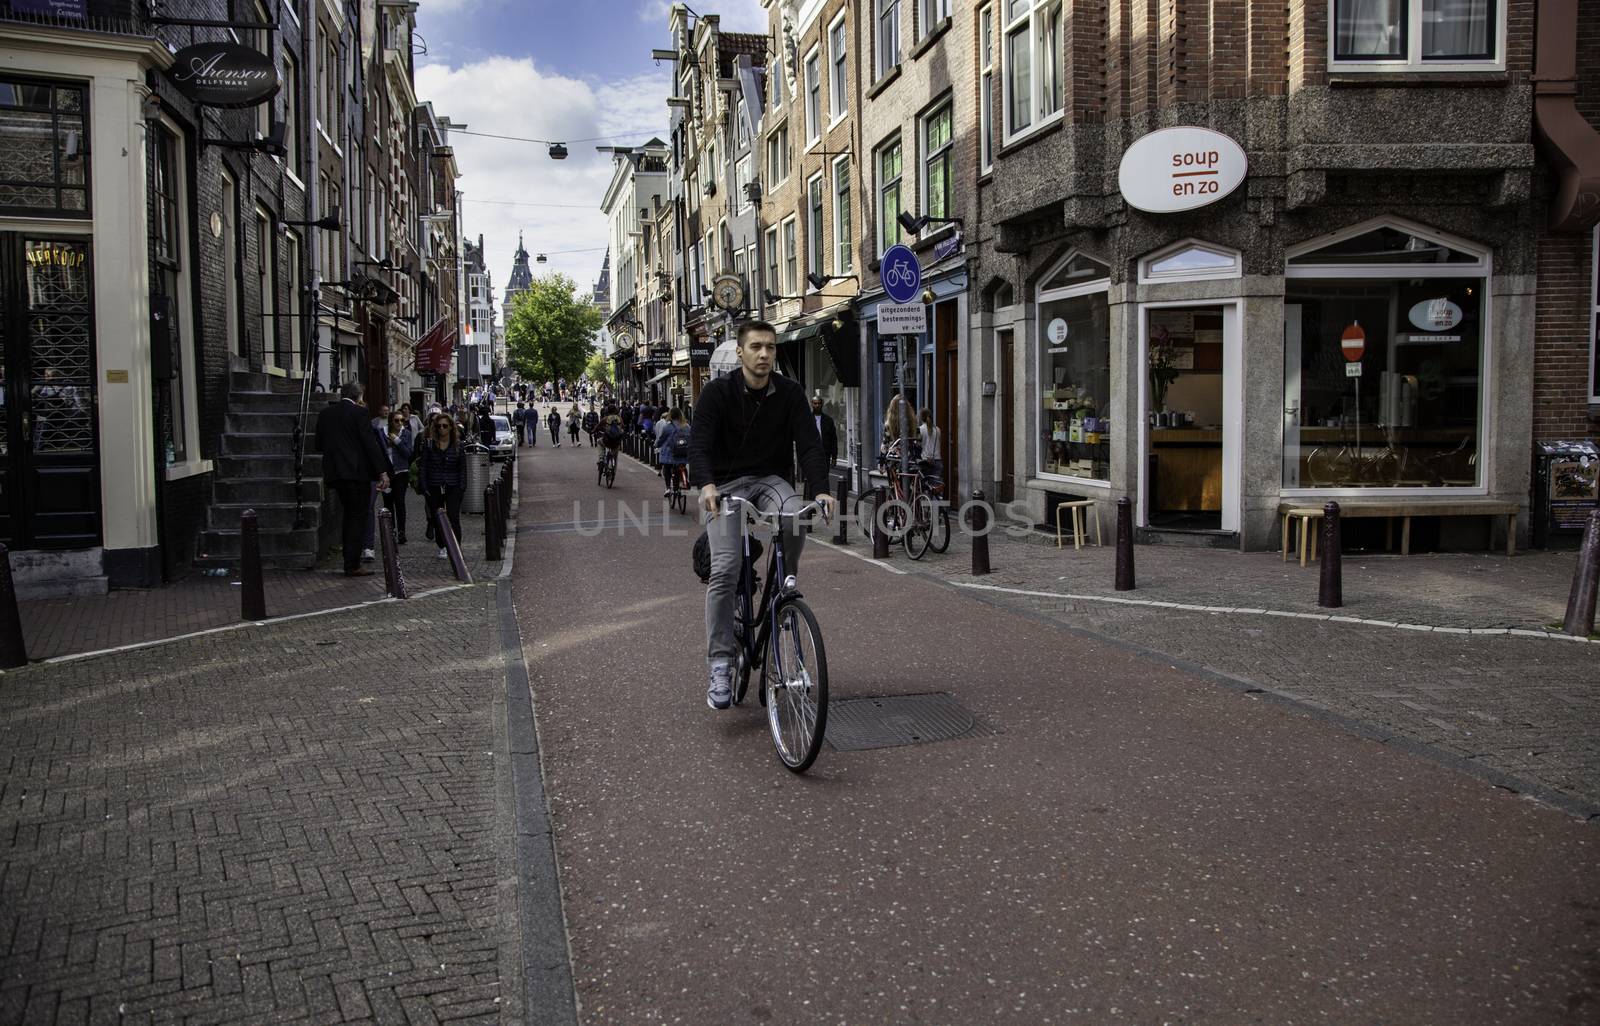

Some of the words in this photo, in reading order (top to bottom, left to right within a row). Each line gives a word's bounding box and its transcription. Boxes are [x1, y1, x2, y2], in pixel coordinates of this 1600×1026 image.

[174, 52, 267, 81] Aronson
[196, 79, 248, 87] DELFTWARE
[1172, 150, 1219, 168] soup
[1173, 182, 1194, 196] en
[1198, 180, 1219, 194] zo
[28, 249, 84, 267] VERKOOP
[881, 306, 921, 314] uitgezonderd
